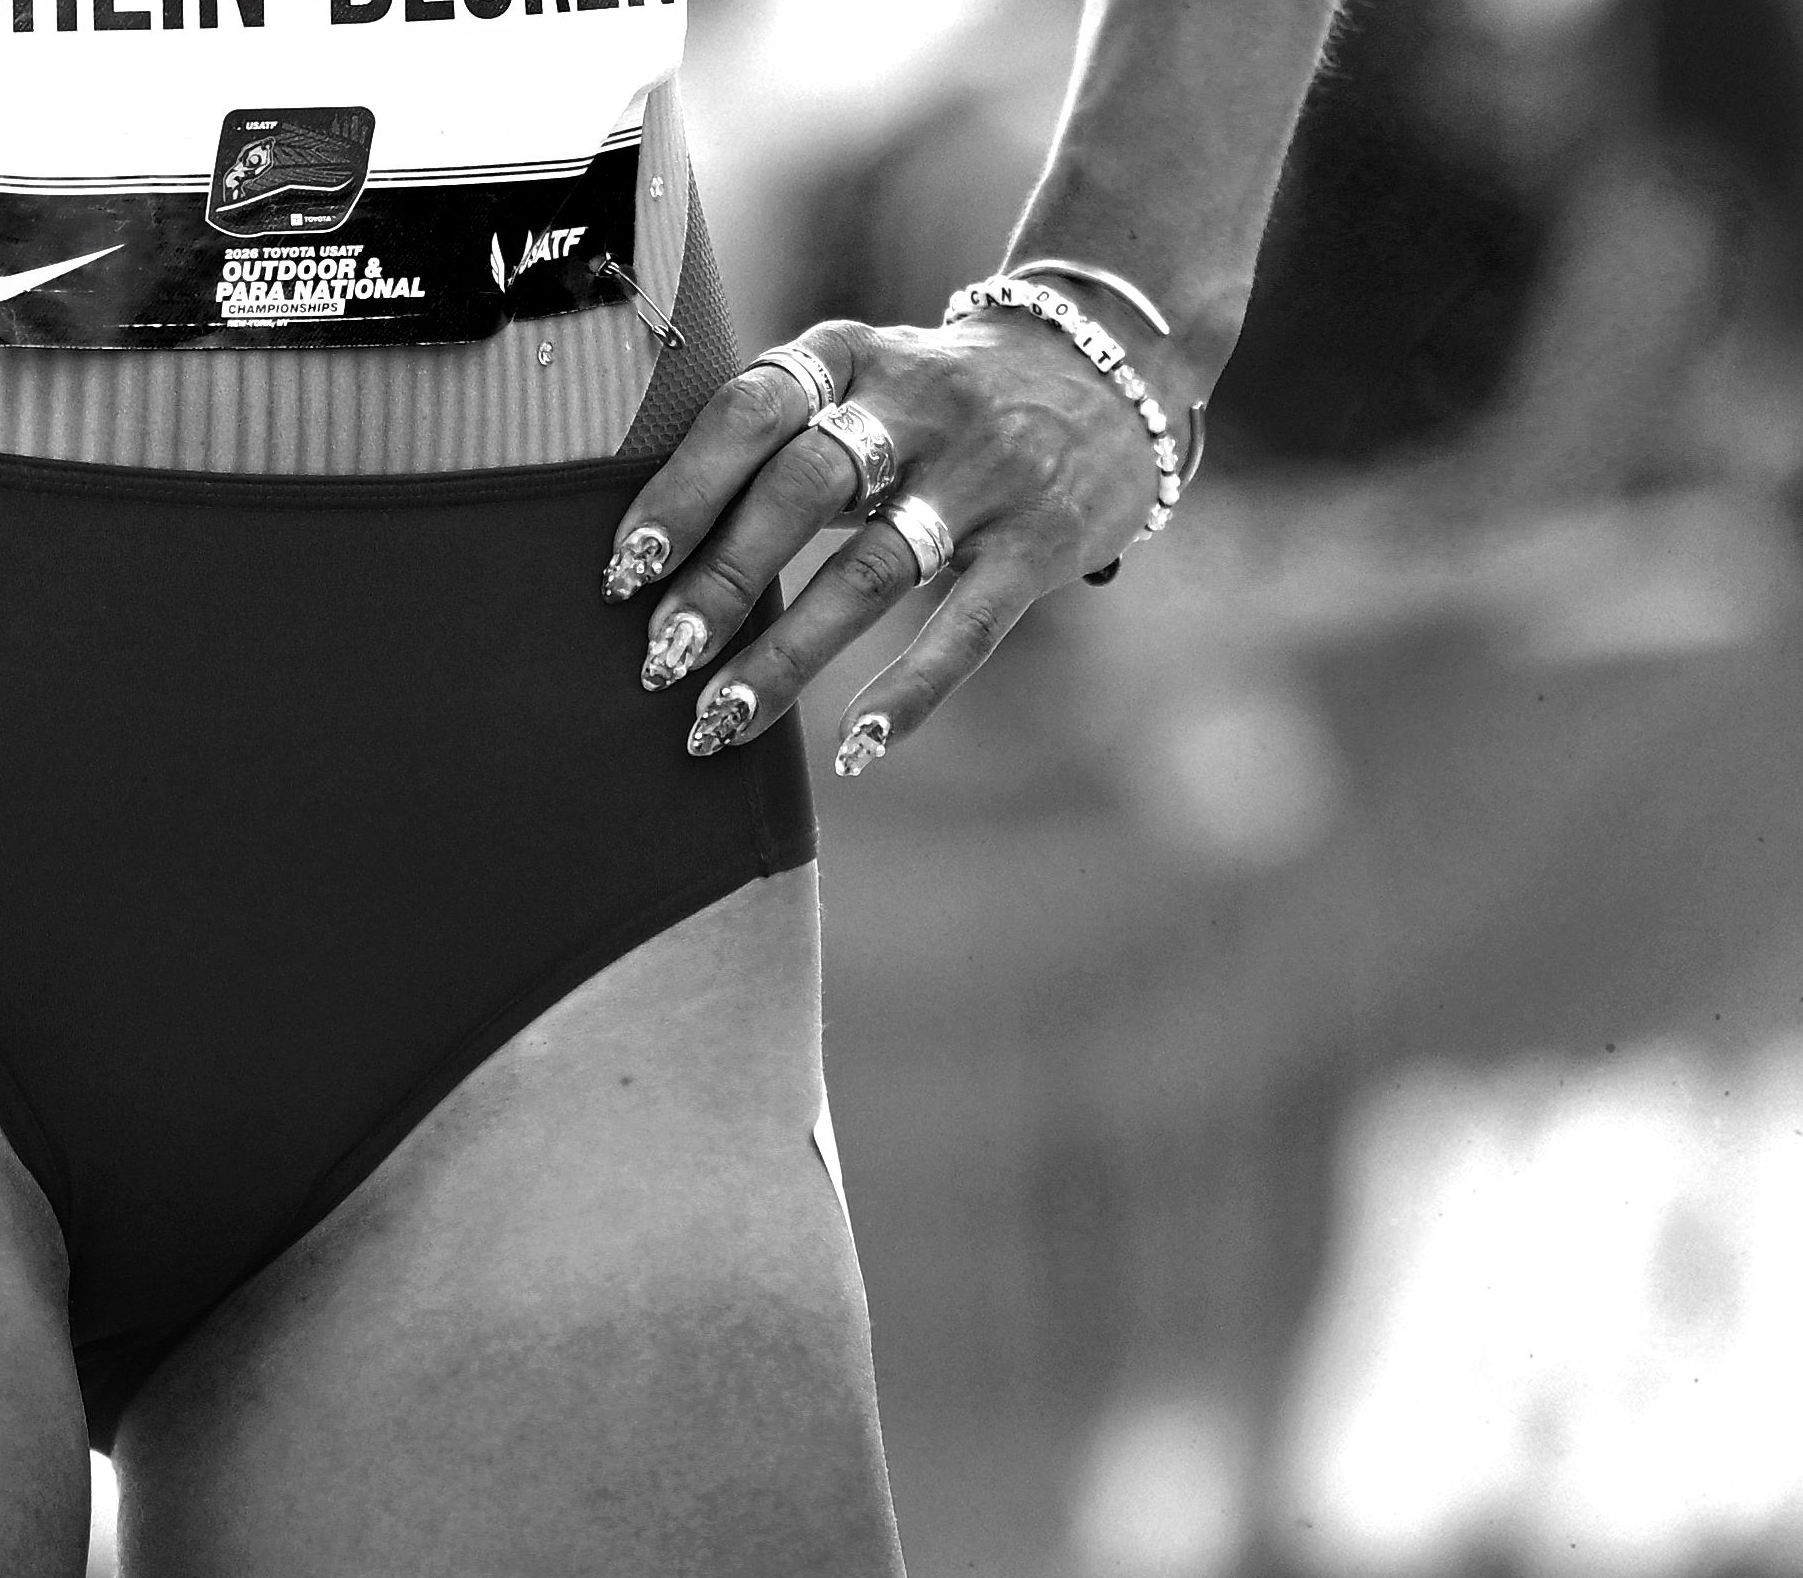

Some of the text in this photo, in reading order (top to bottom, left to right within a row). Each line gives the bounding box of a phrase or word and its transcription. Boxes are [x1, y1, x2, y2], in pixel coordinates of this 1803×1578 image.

[245, 121, 278, 130] USATF
[224, 245, 364, 260] 2026 TOYOTA USATF
[222, 257, 382, 282] OUTDOOR &
[215, 276, 426, 302] PARA NATIONAL
[228, 302, 338, 315] CHAMPIONSHIPS
[970, 287, 1012, 307] CAN
[1082, 336, 1111, 364] IT
